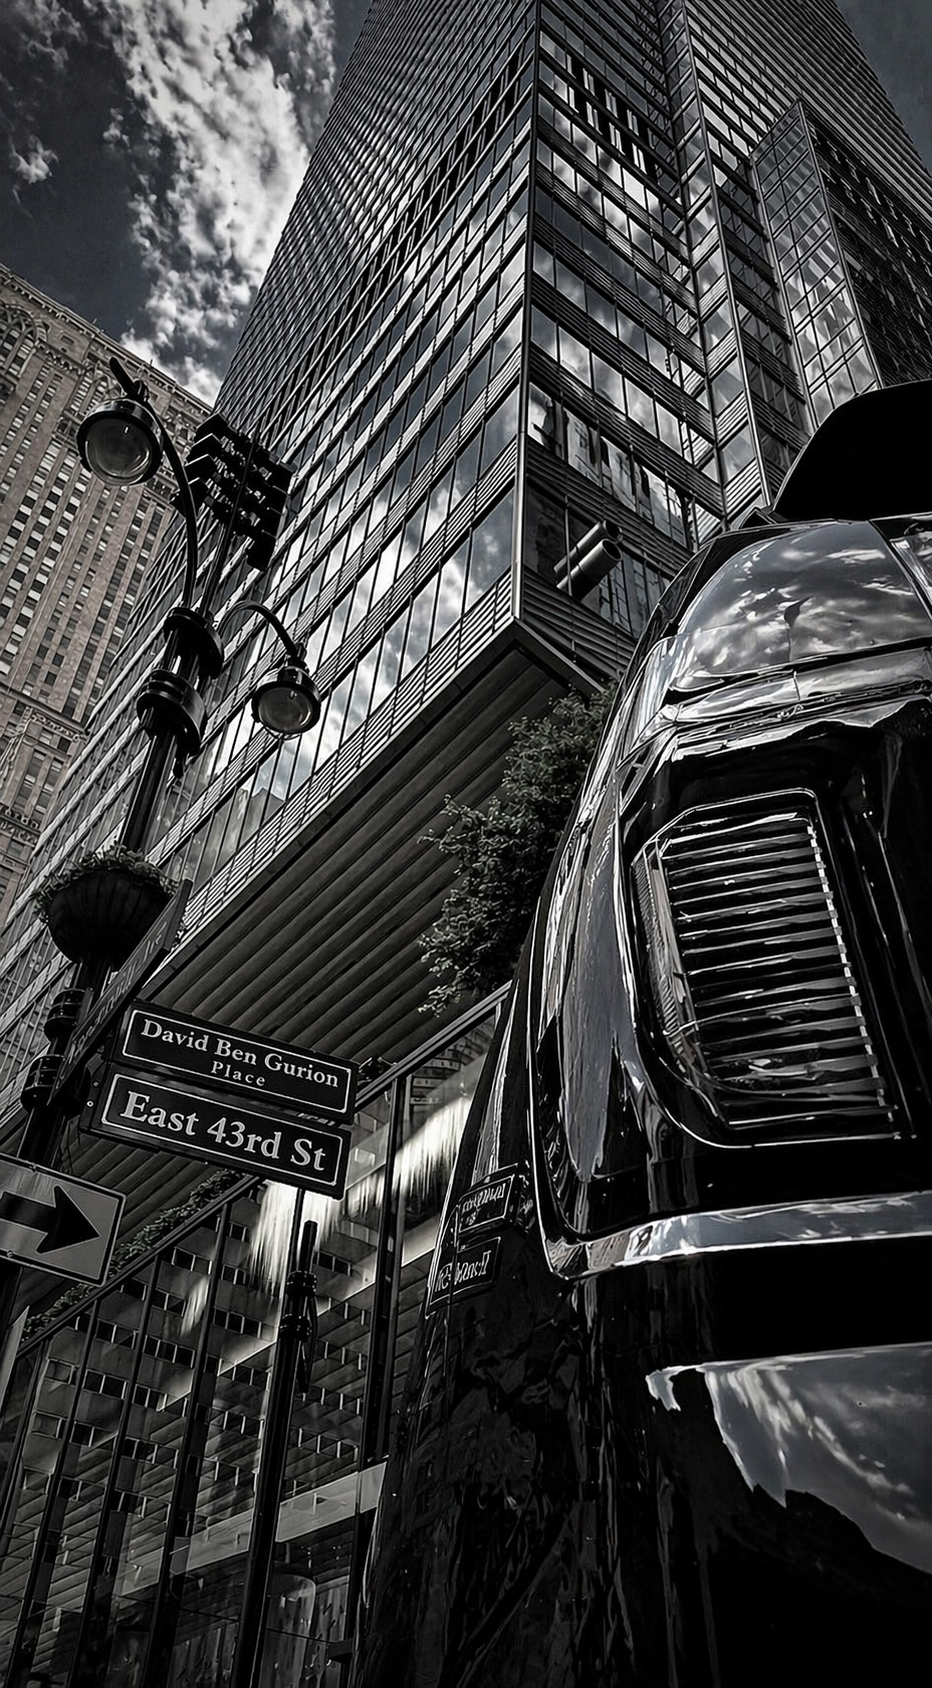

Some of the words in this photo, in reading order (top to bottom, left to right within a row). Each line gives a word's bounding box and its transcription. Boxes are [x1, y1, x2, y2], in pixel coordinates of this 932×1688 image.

[140, 1018, 209, 1052] David
[214, 1038, 258, 1066] Ben
[264, 1053, 339, 1089] Gurion
[210, 1060, 267, 1087] Place
[119, 1090, 200, 1137] East
[206, 1117, 282, 1159] 43rd
[290, 1138, 327, 1172] St
